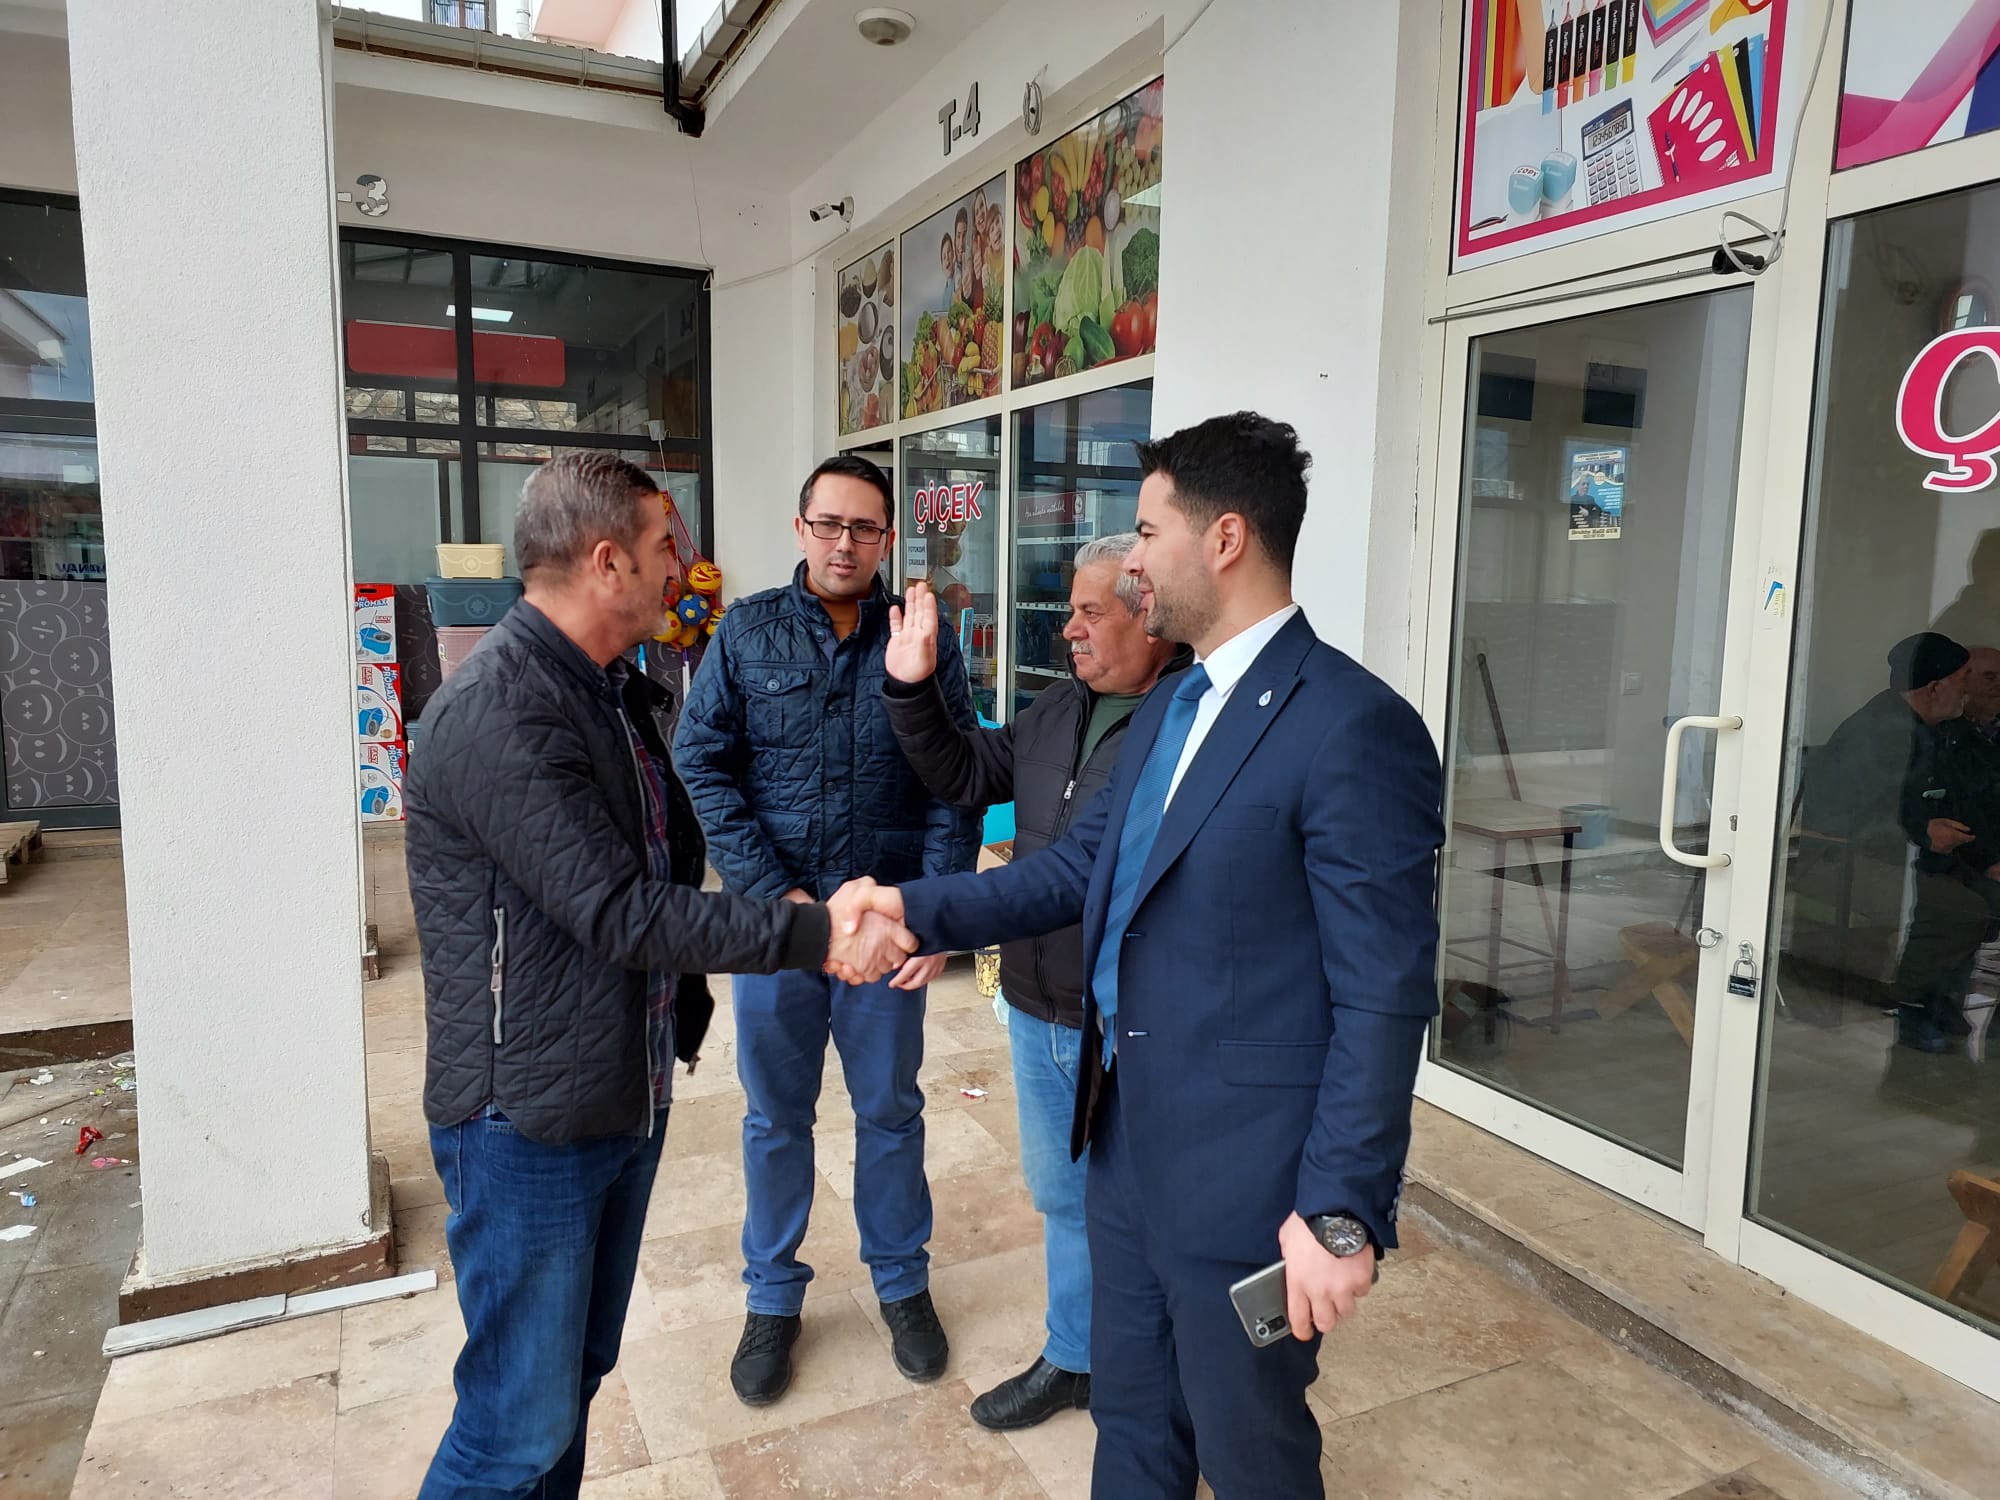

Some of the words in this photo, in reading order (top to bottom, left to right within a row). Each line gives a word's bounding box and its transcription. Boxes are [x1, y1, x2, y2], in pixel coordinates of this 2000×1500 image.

[938, 80, 981, 156] T-4
[1517, 167, 1538, 177] COPY
[913, 480, 984, 534] ÇİÇEK
[382, 665, 397, 701] PROMAX
[371, 746, 379, 765] EASY
[387, 744, 402, 780] PROMAX
